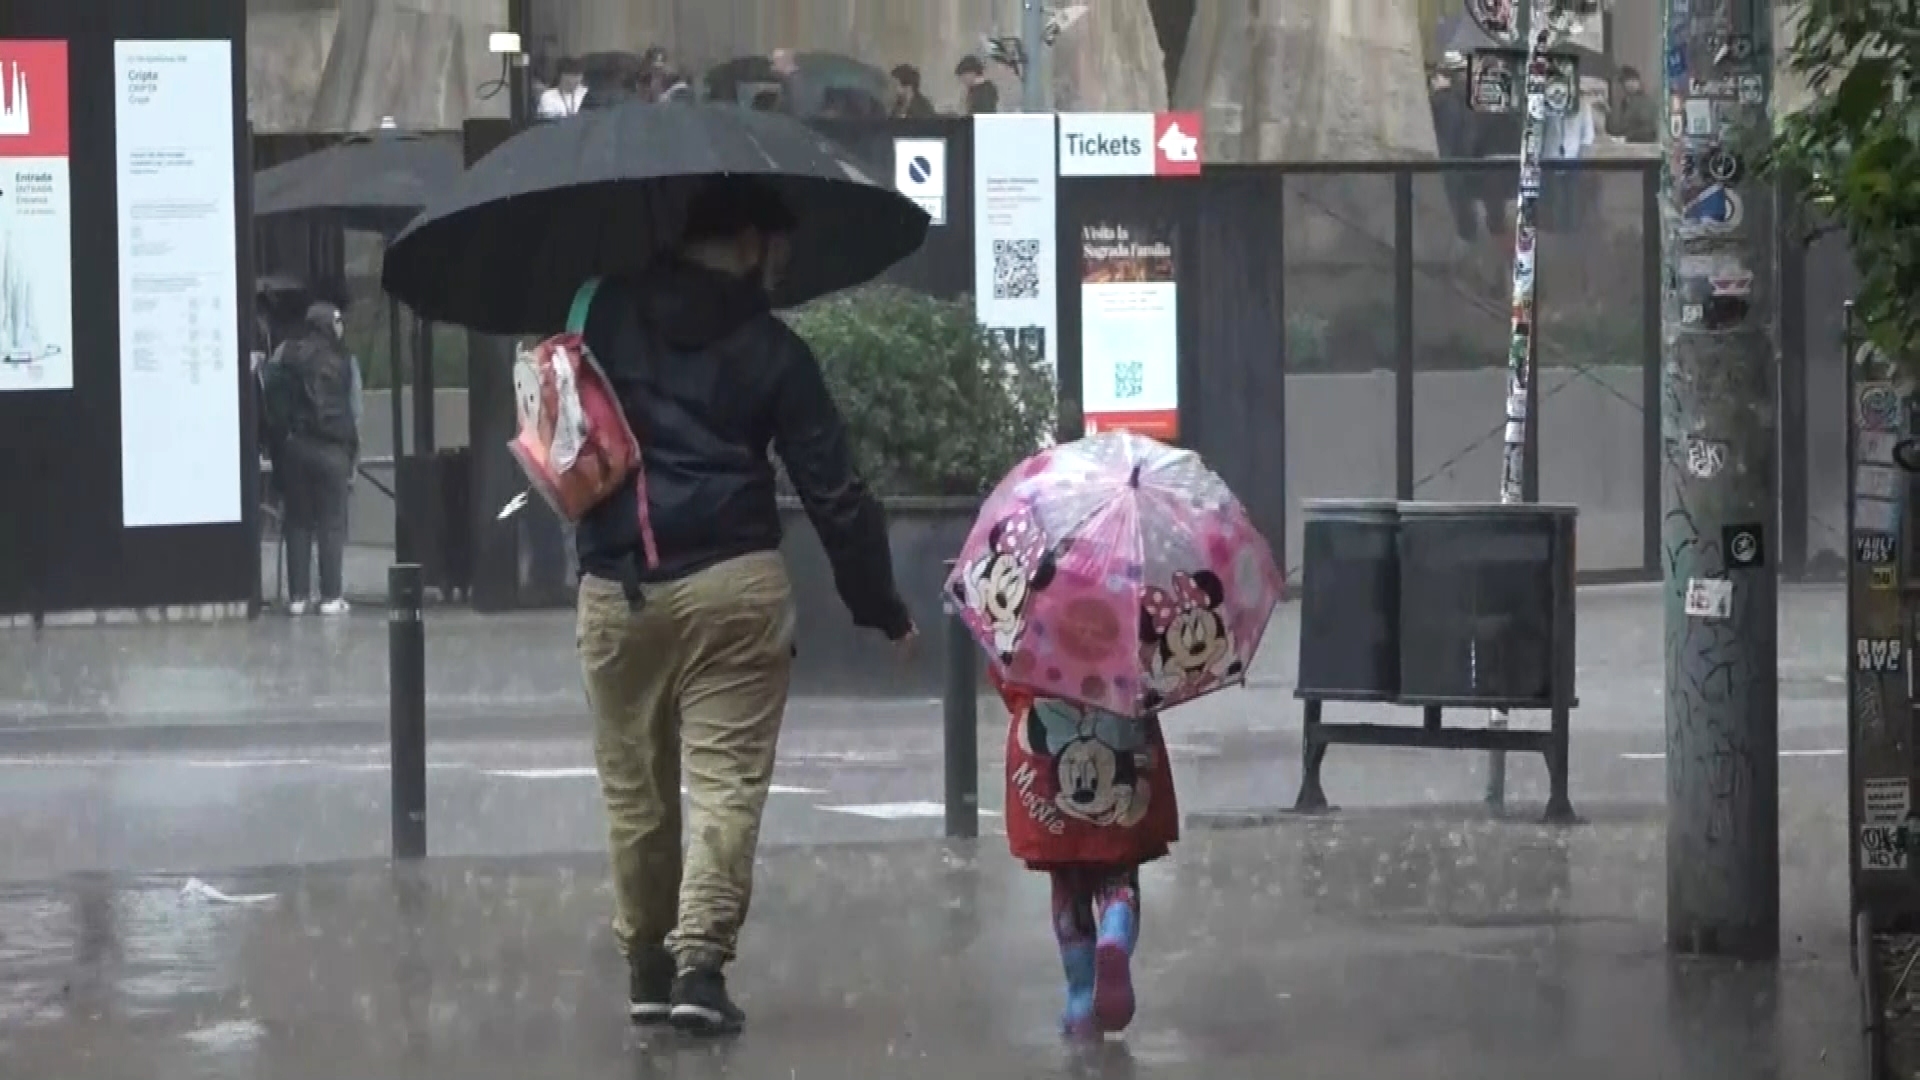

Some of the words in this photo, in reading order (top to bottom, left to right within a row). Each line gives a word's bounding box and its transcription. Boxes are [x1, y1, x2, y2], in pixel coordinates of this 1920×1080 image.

[127, 70, 158, 82] Cripta
[1066, 133, 1142, 157] Tickets
[15, 172, 53, 182] Entrada
[1082, 224, 1115, 240] Visita
[1117, 224, 1129, 240] la
[1083, 243, 1129, 258] Sagrada
